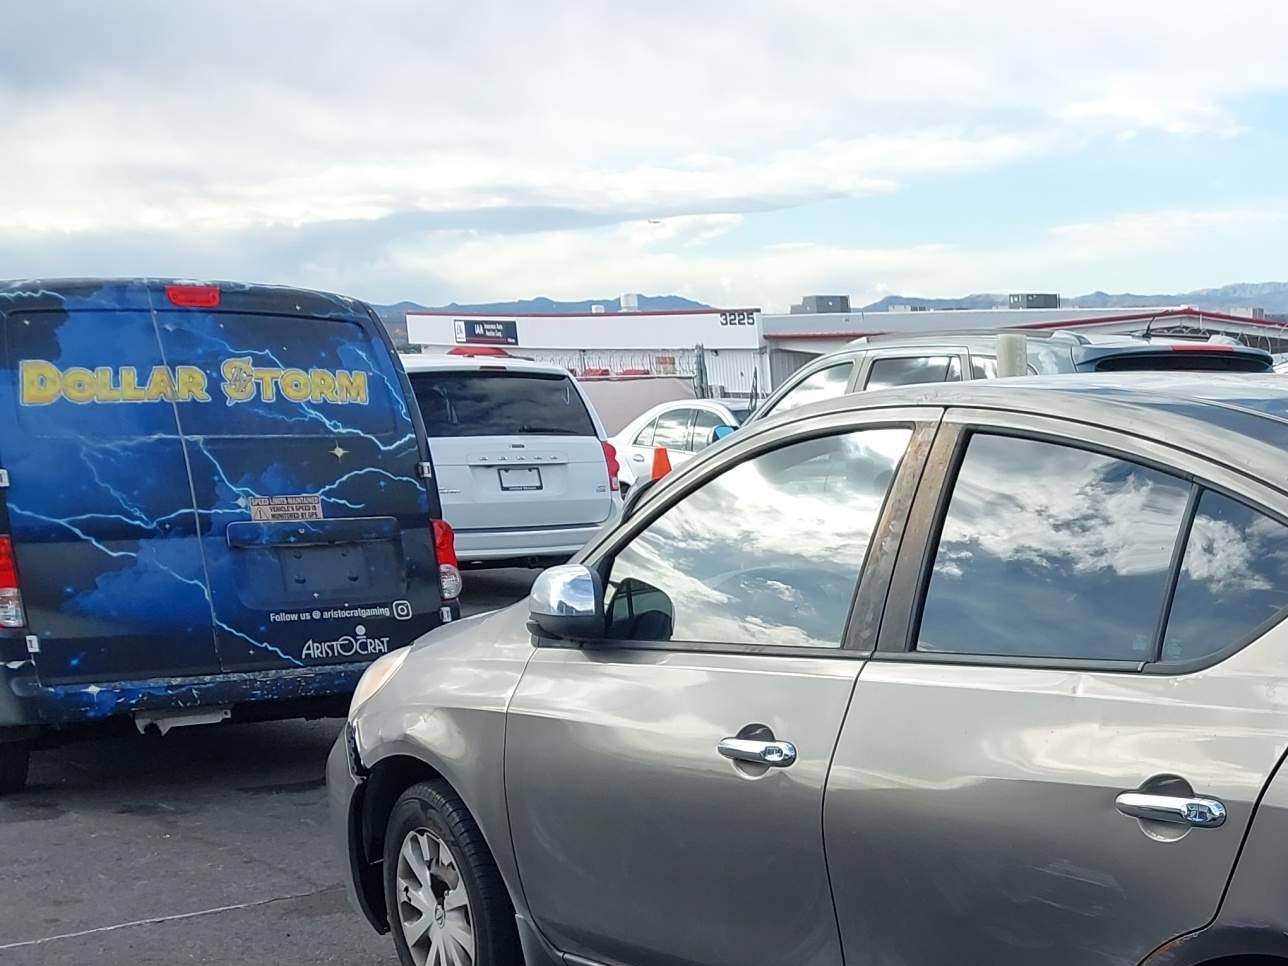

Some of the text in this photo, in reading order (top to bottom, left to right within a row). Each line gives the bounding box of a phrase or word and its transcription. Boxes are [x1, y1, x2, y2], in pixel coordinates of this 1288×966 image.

[720, 312, 755, 326] 3225
[19, 357, 369, 405] DOLLAR STORM
[270, 612, 298, 622] Follow
[322, 606, 390, 619] aristocratgaming
[302, 635, 390, 659] ARISTOCRAT
